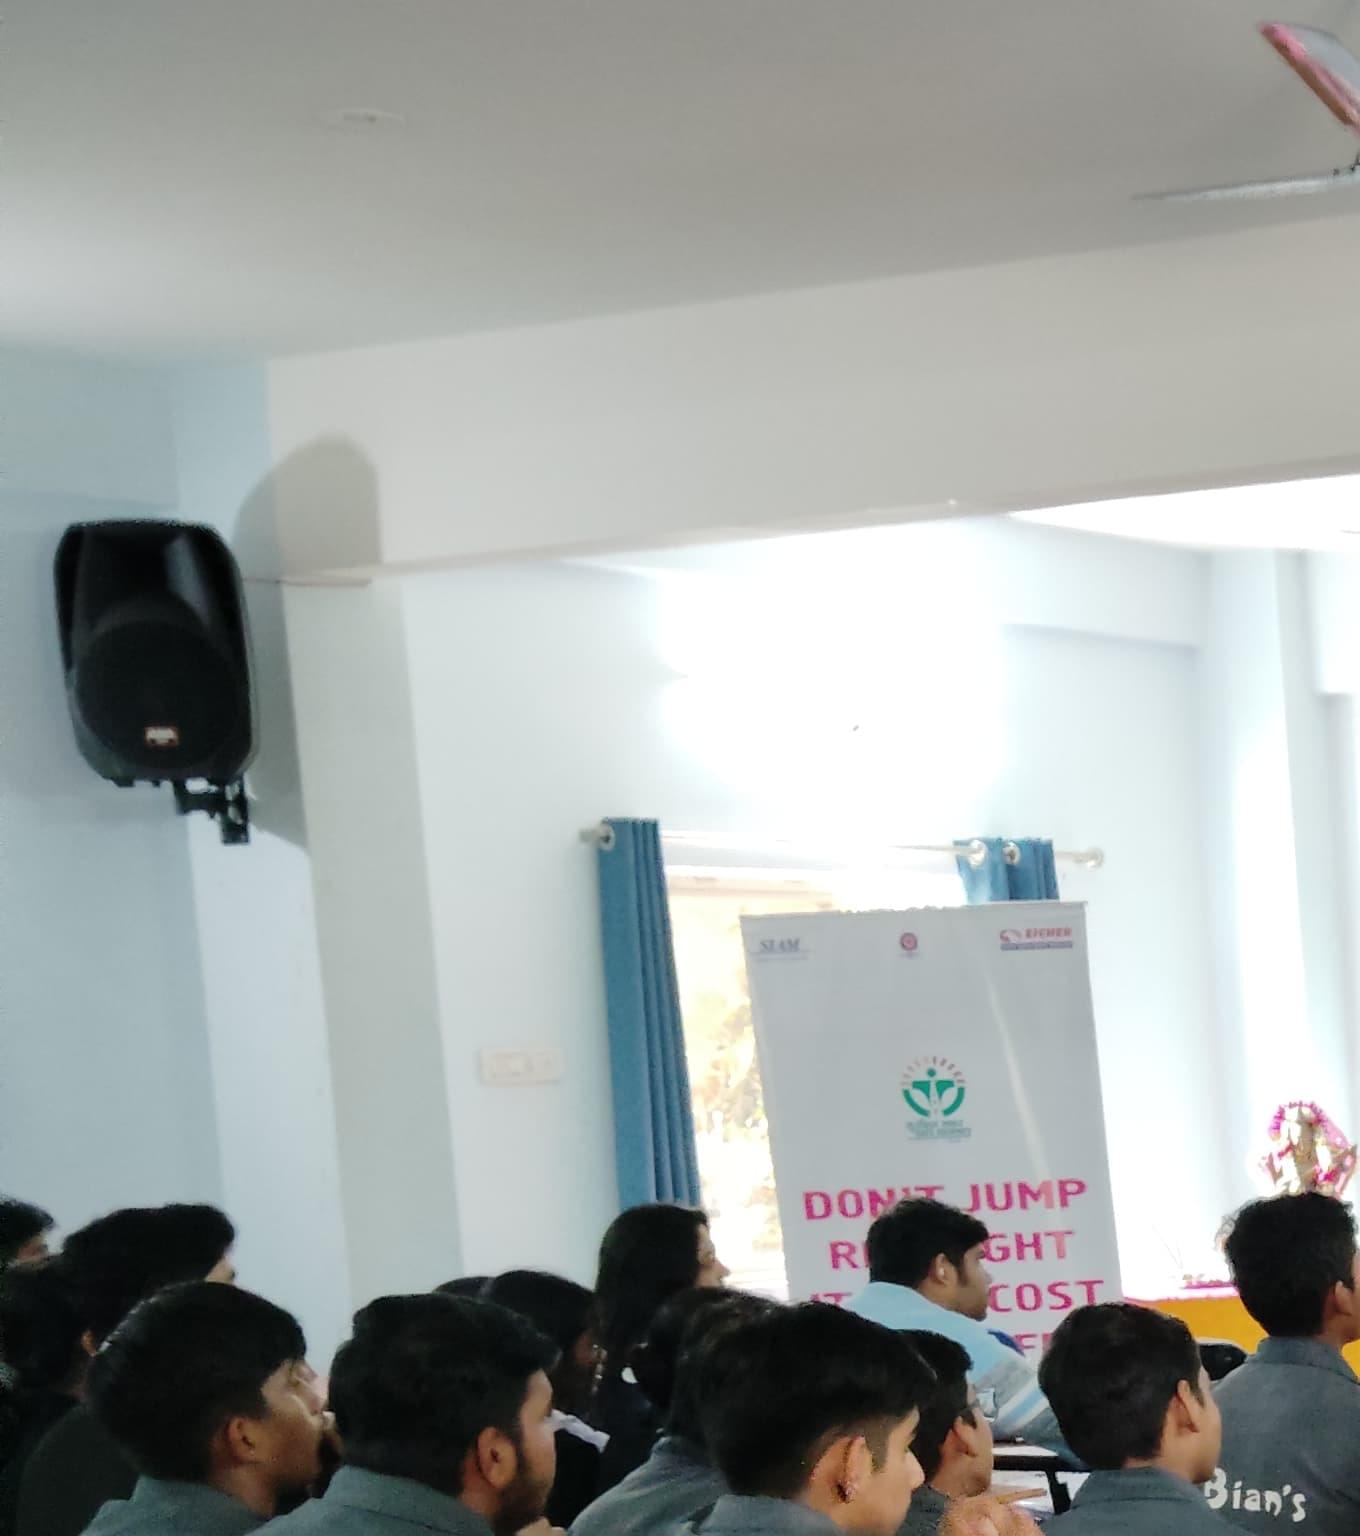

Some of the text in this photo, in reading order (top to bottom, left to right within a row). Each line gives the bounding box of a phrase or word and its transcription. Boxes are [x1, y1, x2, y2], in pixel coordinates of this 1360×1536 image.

[759, 938, 801, 952] SIAM
[967, 1178, 1087, 1213] JUMP
[983, 1230, 1075, 1263] GHT
[988, 1279, 1105, 1313] COST
[1203, 1466, 1307, 1523] Bian's
